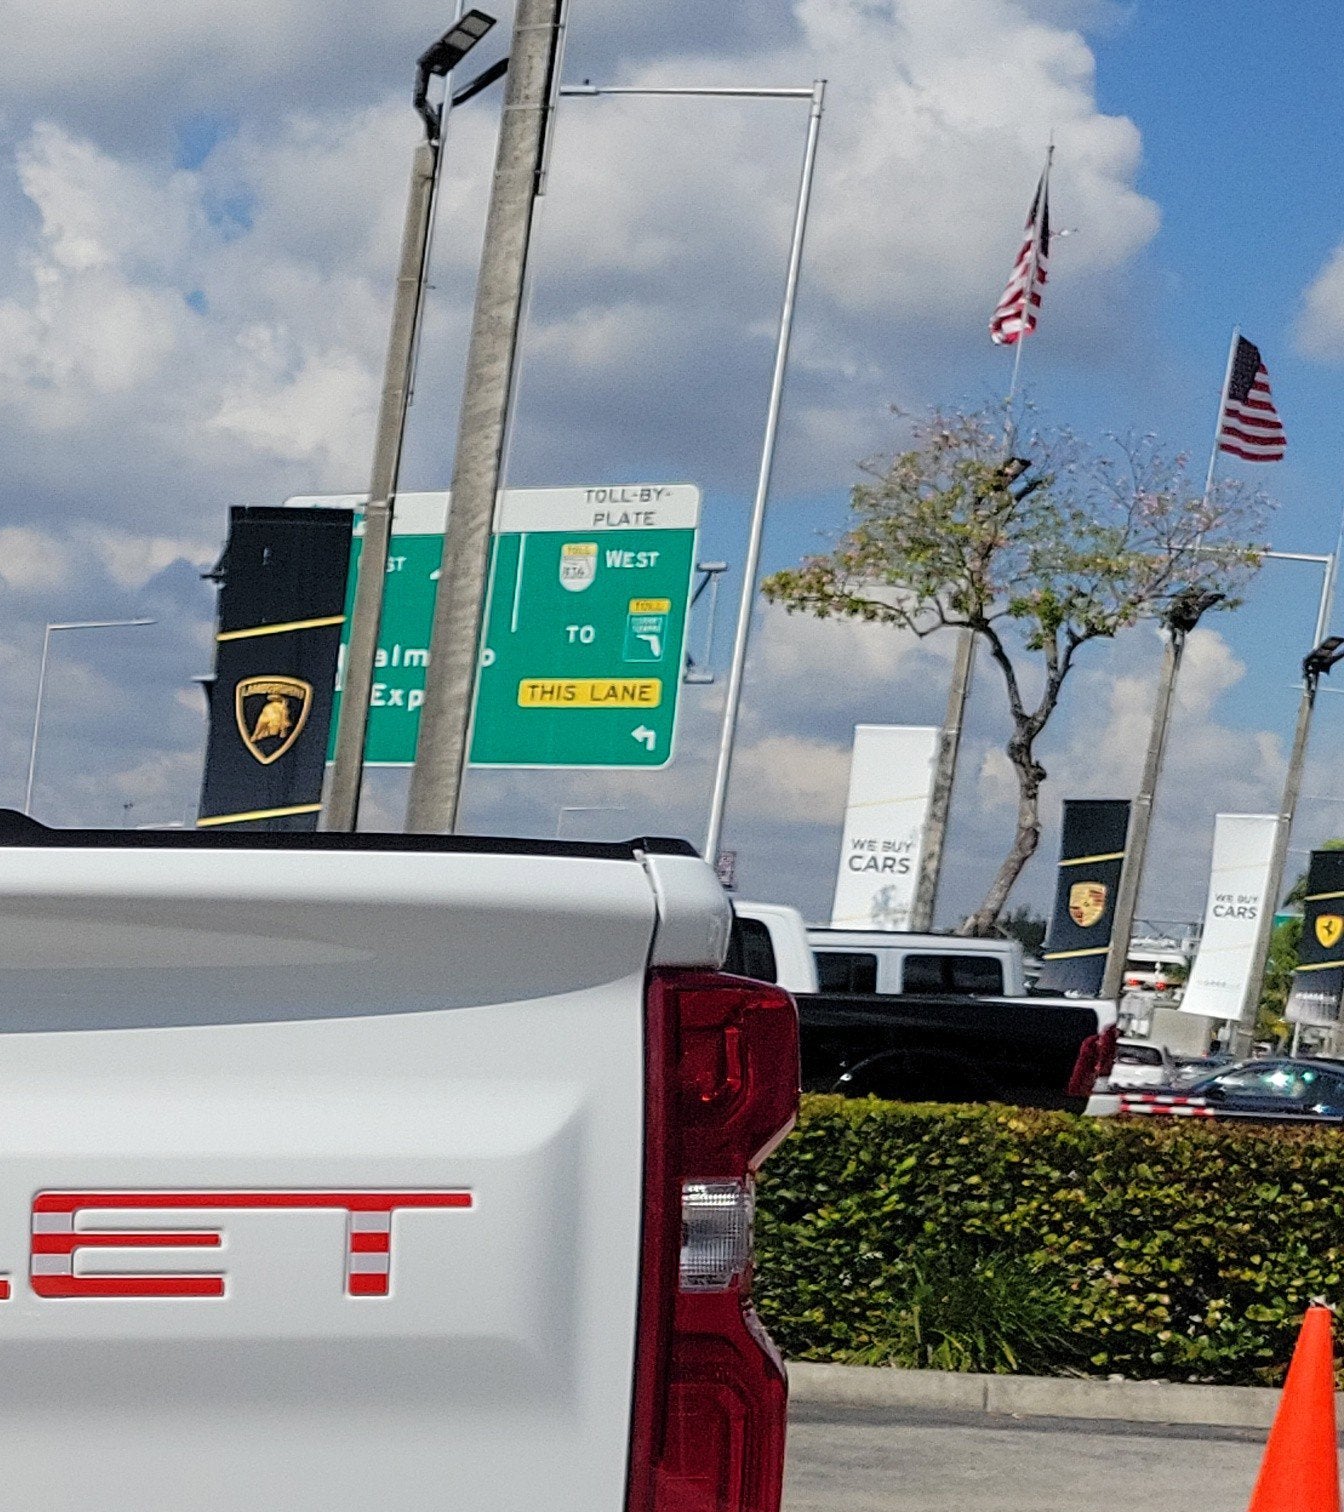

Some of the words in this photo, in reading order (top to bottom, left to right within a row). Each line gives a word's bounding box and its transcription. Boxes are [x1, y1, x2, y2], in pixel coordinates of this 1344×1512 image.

[585, 488, 672, 504] TOLL-BY-
[593, 511, 658, 527] PLATE
[606, 549, 661, 569] WEST
[565, 624, 596, 644] TO
[528, 684, 577, 701] THIS
[590, 684, 653, 702] LANE
[852, 839, 878, 852] WE
[881, 840, 913, 853] BUY
[848, 854, 911, 874] CARS
[1215, 893, 1234, 902] WE
[1236, 894, 1259, 904] BUY
[1212, 904, 1258, 920] CARS
